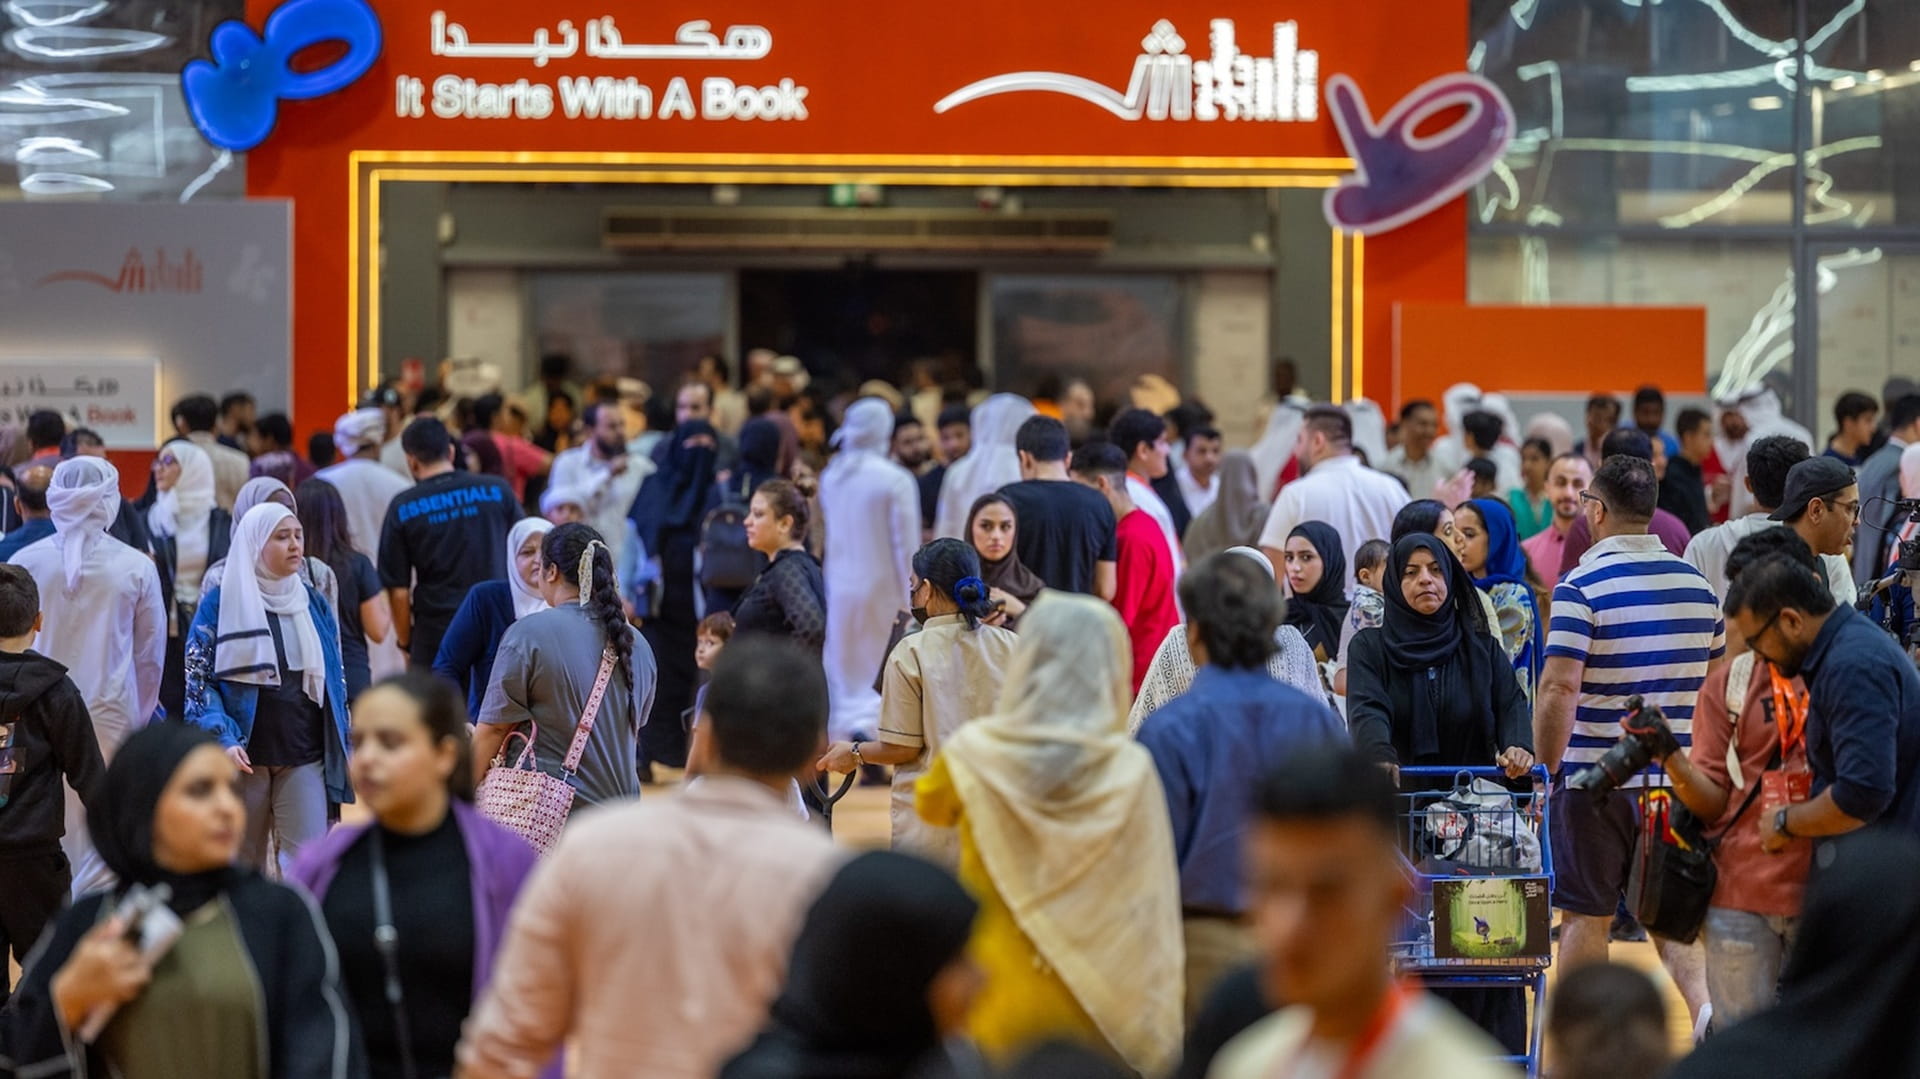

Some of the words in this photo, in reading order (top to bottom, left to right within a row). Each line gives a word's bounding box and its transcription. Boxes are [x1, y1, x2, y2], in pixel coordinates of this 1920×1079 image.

[585, 15, 772, 60] هكذا
[396, 75, 424, 118] It
[431, 75, 554, 119] Starts
[557, 76, 653, 120] With
[658, 77, 696, 120] A
[701, 77, 809, 121] Book
[398, 485, 503, 522] ESSENTIALS
